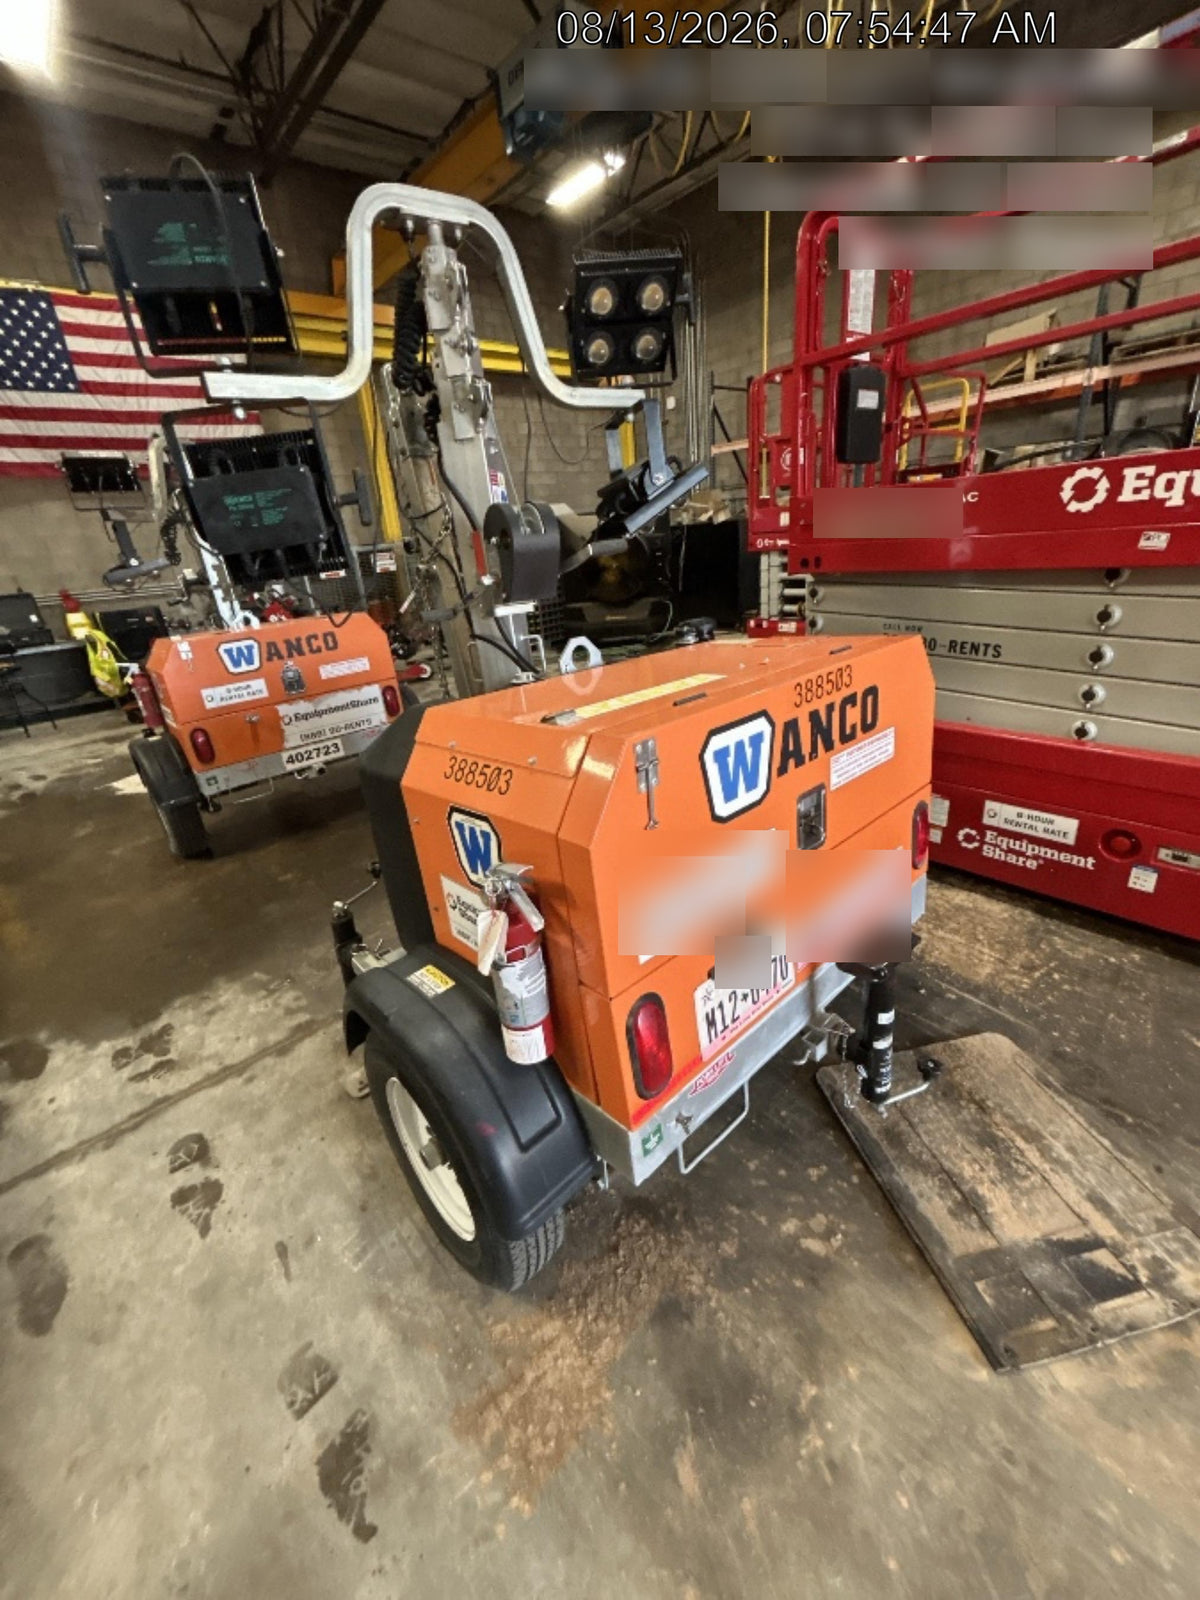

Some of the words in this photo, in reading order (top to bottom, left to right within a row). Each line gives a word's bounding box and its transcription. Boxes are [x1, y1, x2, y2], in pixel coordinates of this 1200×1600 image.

[223, 631, 338, 669] WANCO
[794, 664, 852, 708] 388503
[285, 742, 341, 765] 402723
[713, 684, 879, 804] WANCO
[444, 755, 513, 796] 388503
[1004, 817, 1040, 833] RENTAL
[455, 820, 492, 878] W
[985, 830, 1097, 871] Equipment
